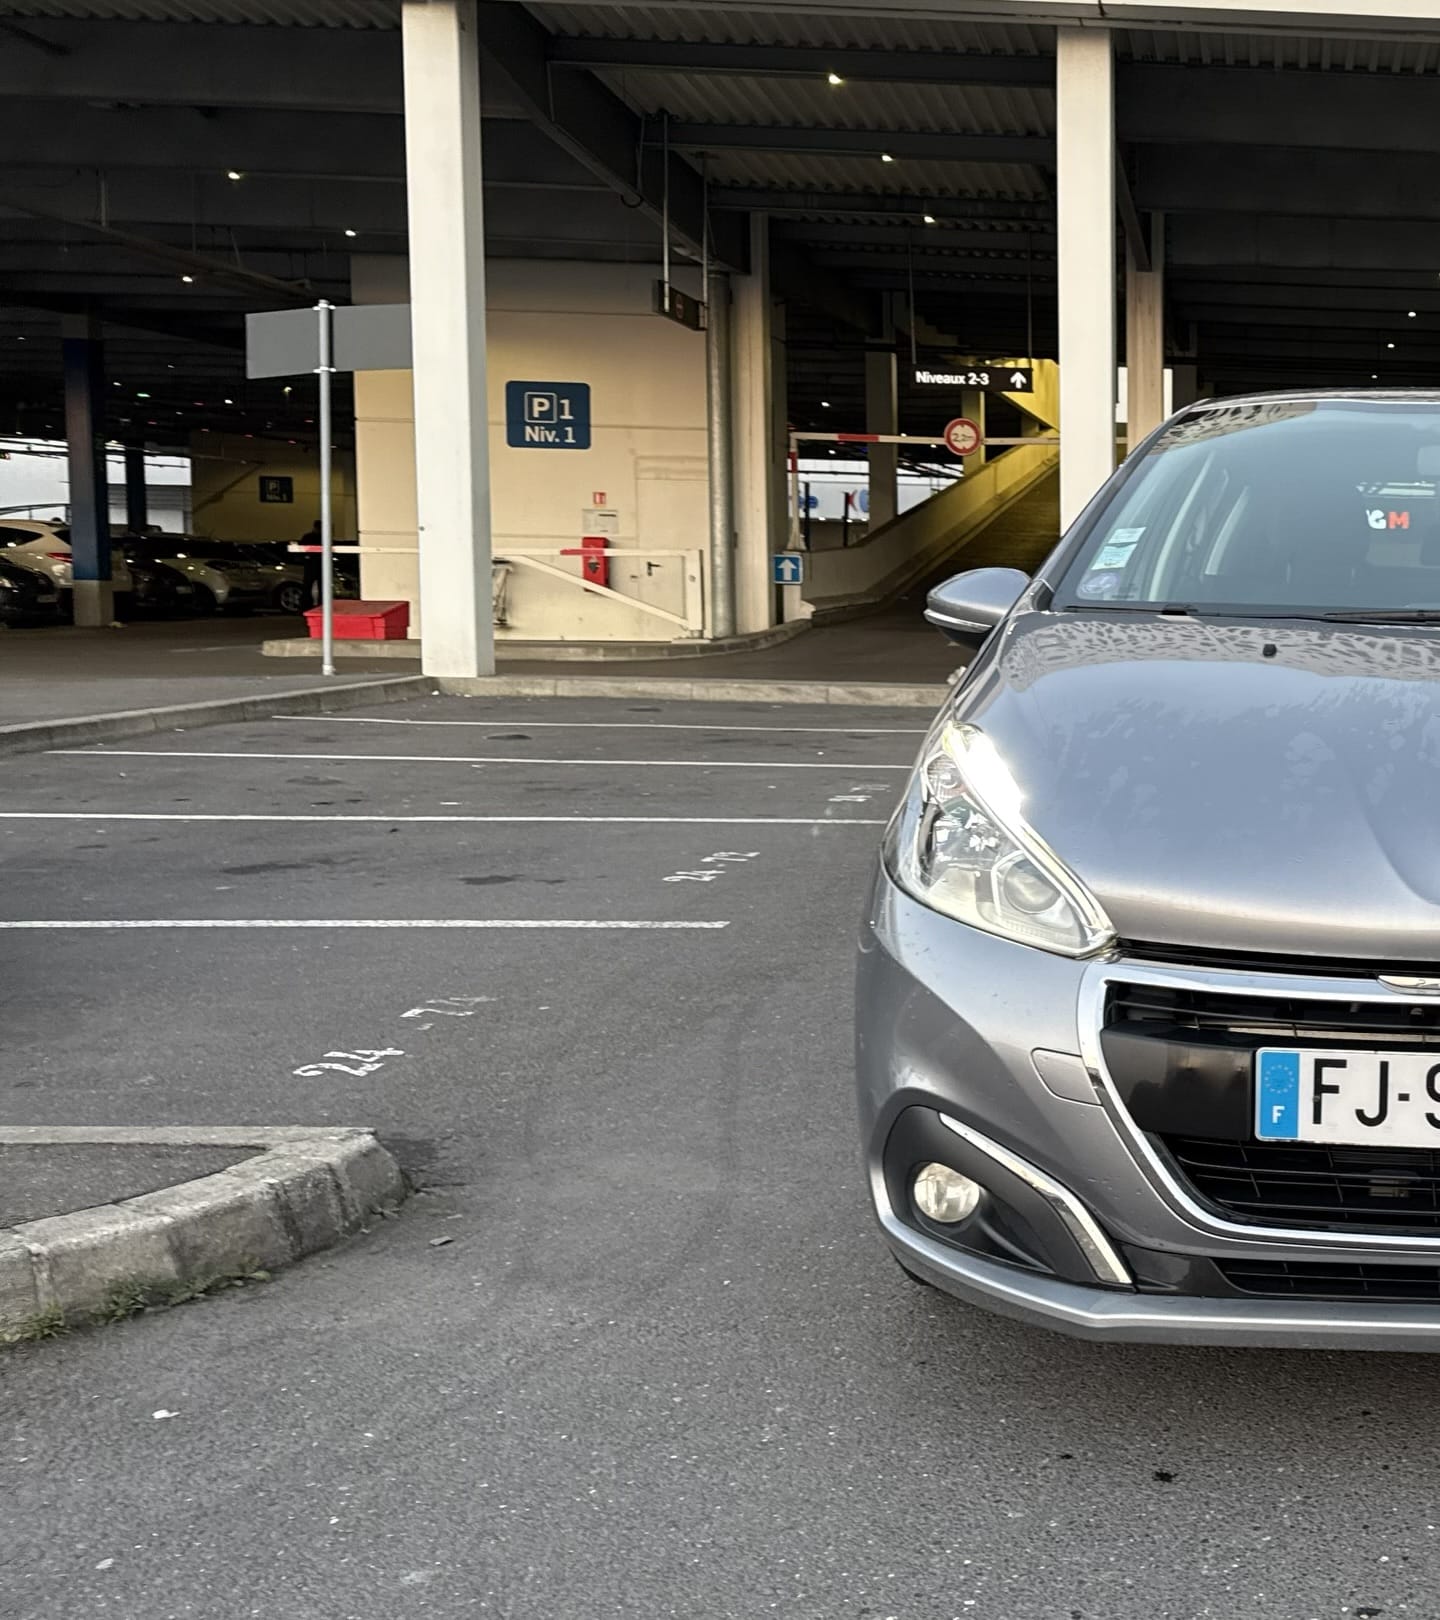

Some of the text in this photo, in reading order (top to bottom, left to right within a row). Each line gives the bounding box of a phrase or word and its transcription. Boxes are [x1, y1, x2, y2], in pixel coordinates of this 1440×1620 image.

[915, 370, 990, 386] Niveaux 2-3
[531, 397, 575, 420] P 1
[524, 425, 577, 443] Niv. 1
[1271, 1105, 1286, 1124] F
